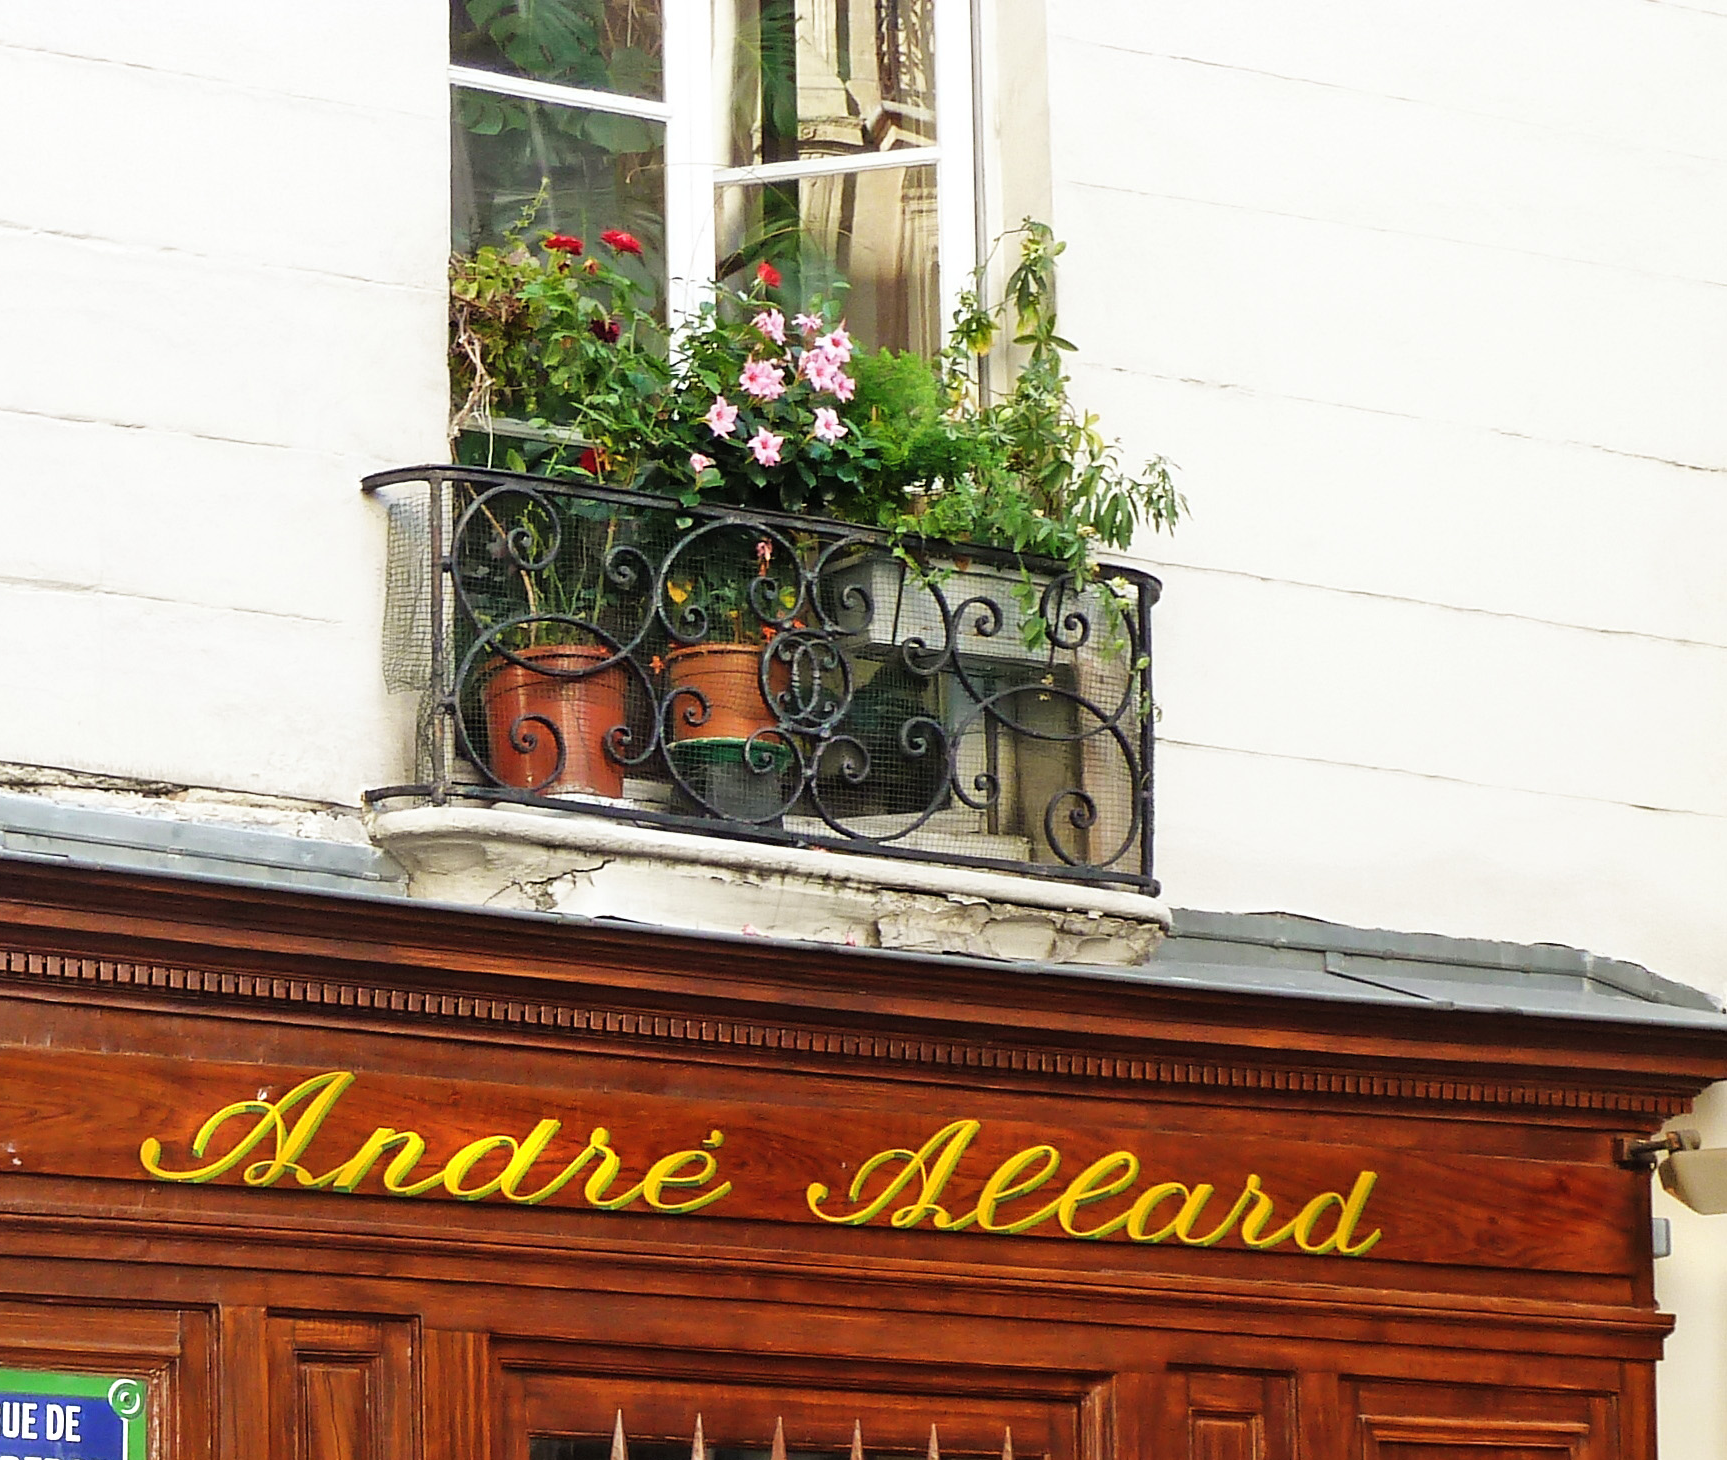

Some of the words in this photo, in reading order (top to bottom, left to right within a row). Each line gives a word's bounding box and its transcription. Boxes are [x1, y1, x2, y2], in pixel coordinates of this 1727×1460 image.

[139, 1070, 733, 1214] André
[806, 1118, 1382, 1257] Allard
[45, 1403, 82, 1443] DE
